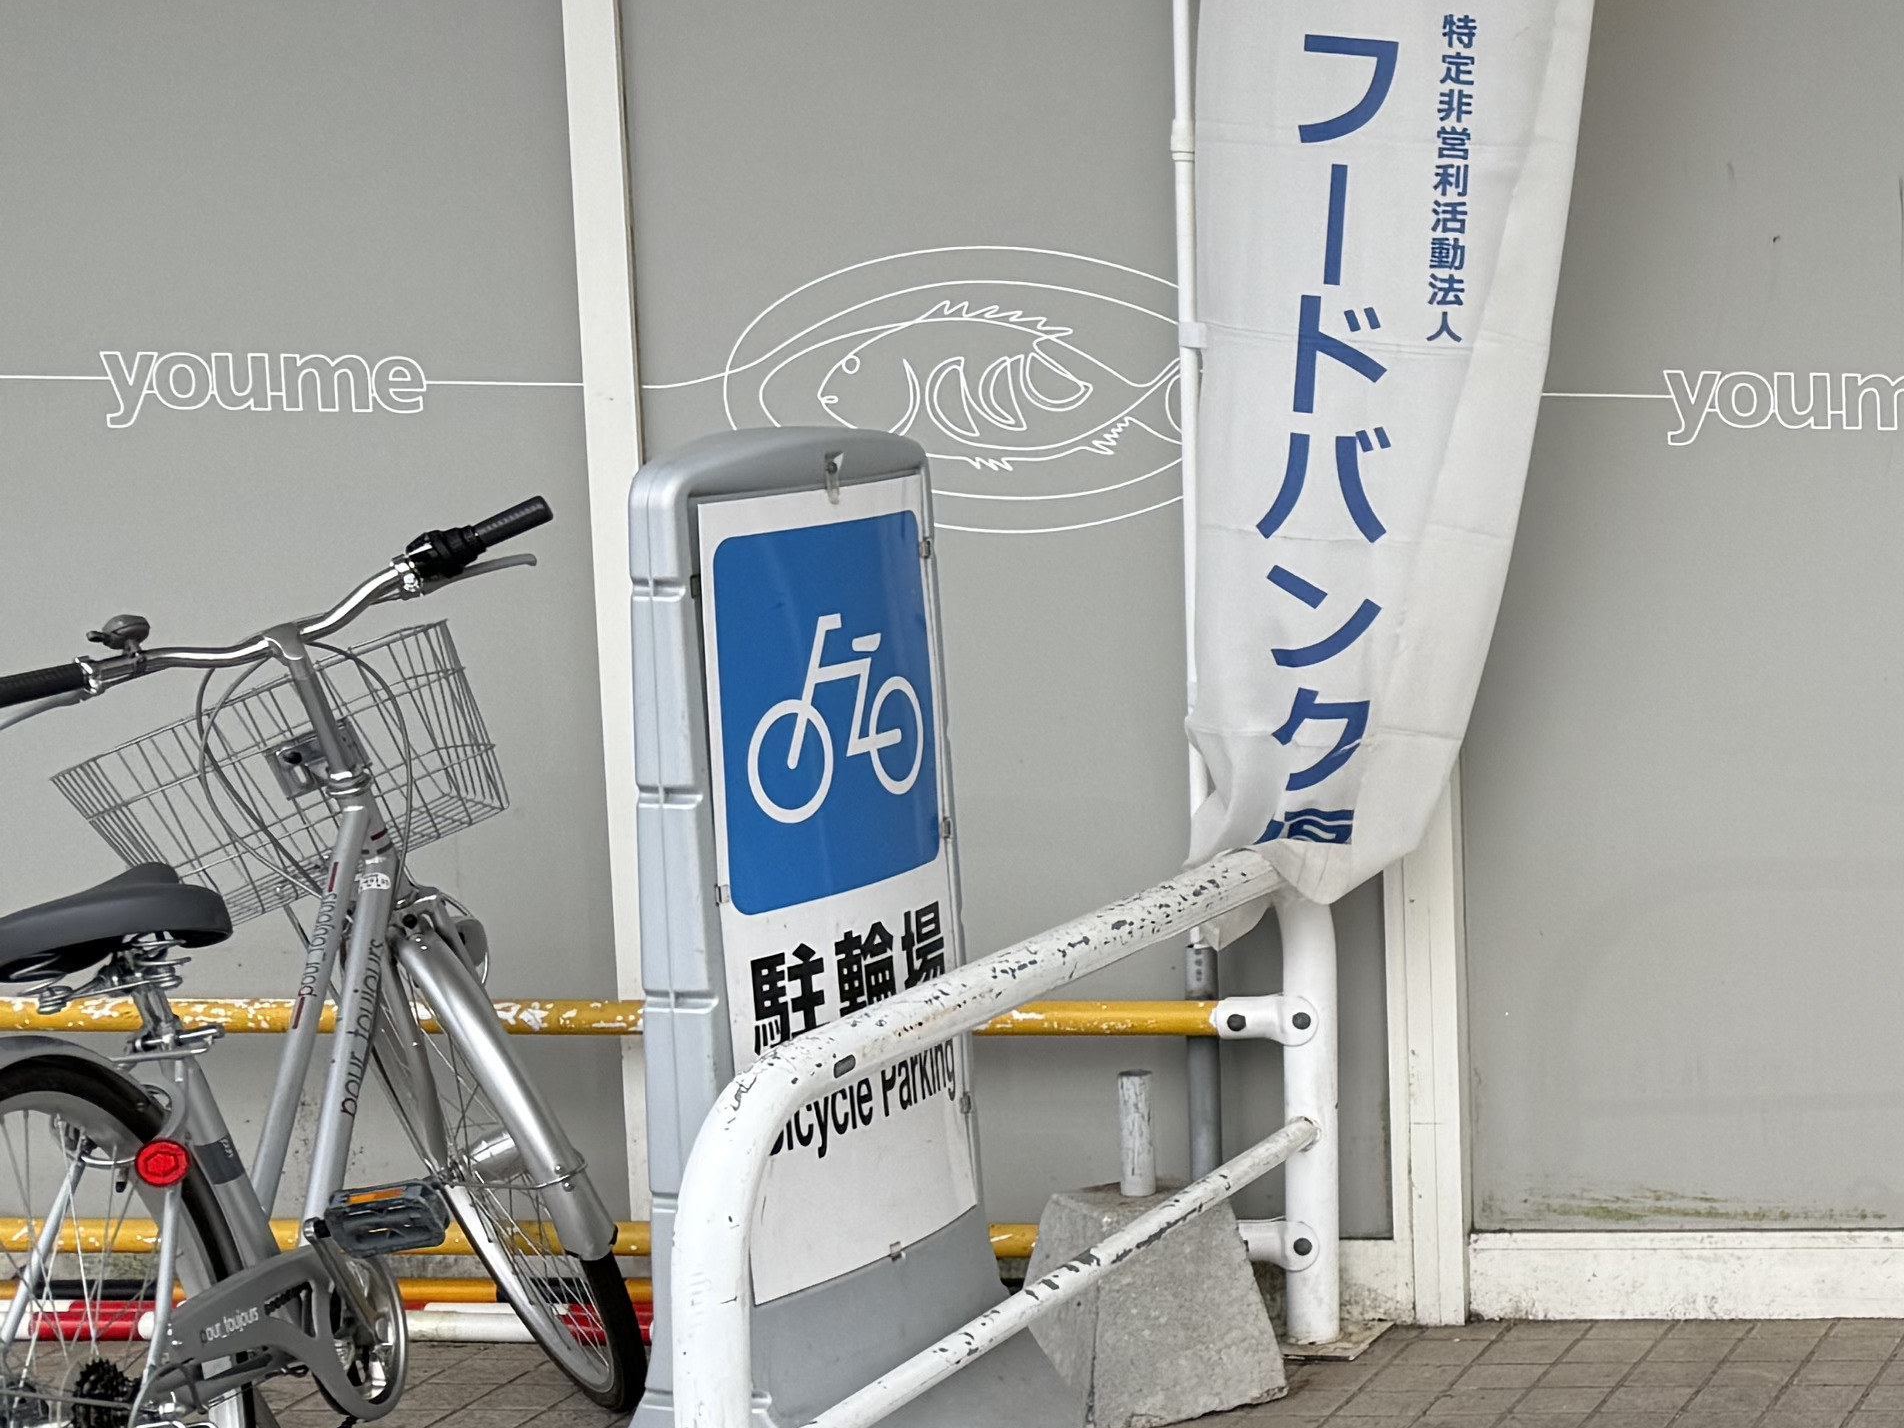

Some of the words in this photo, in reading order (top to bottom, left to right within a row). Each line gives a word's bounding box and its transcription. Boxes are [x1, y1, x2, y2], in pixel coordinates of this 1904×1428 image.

[1426, 13, 1477, 343] 特定非営利活動法人
[99, 350, 427, 429] youme
[750, 900, 946, 1056] 駐輪場
[880, 1039, 957, 1118] Parking
